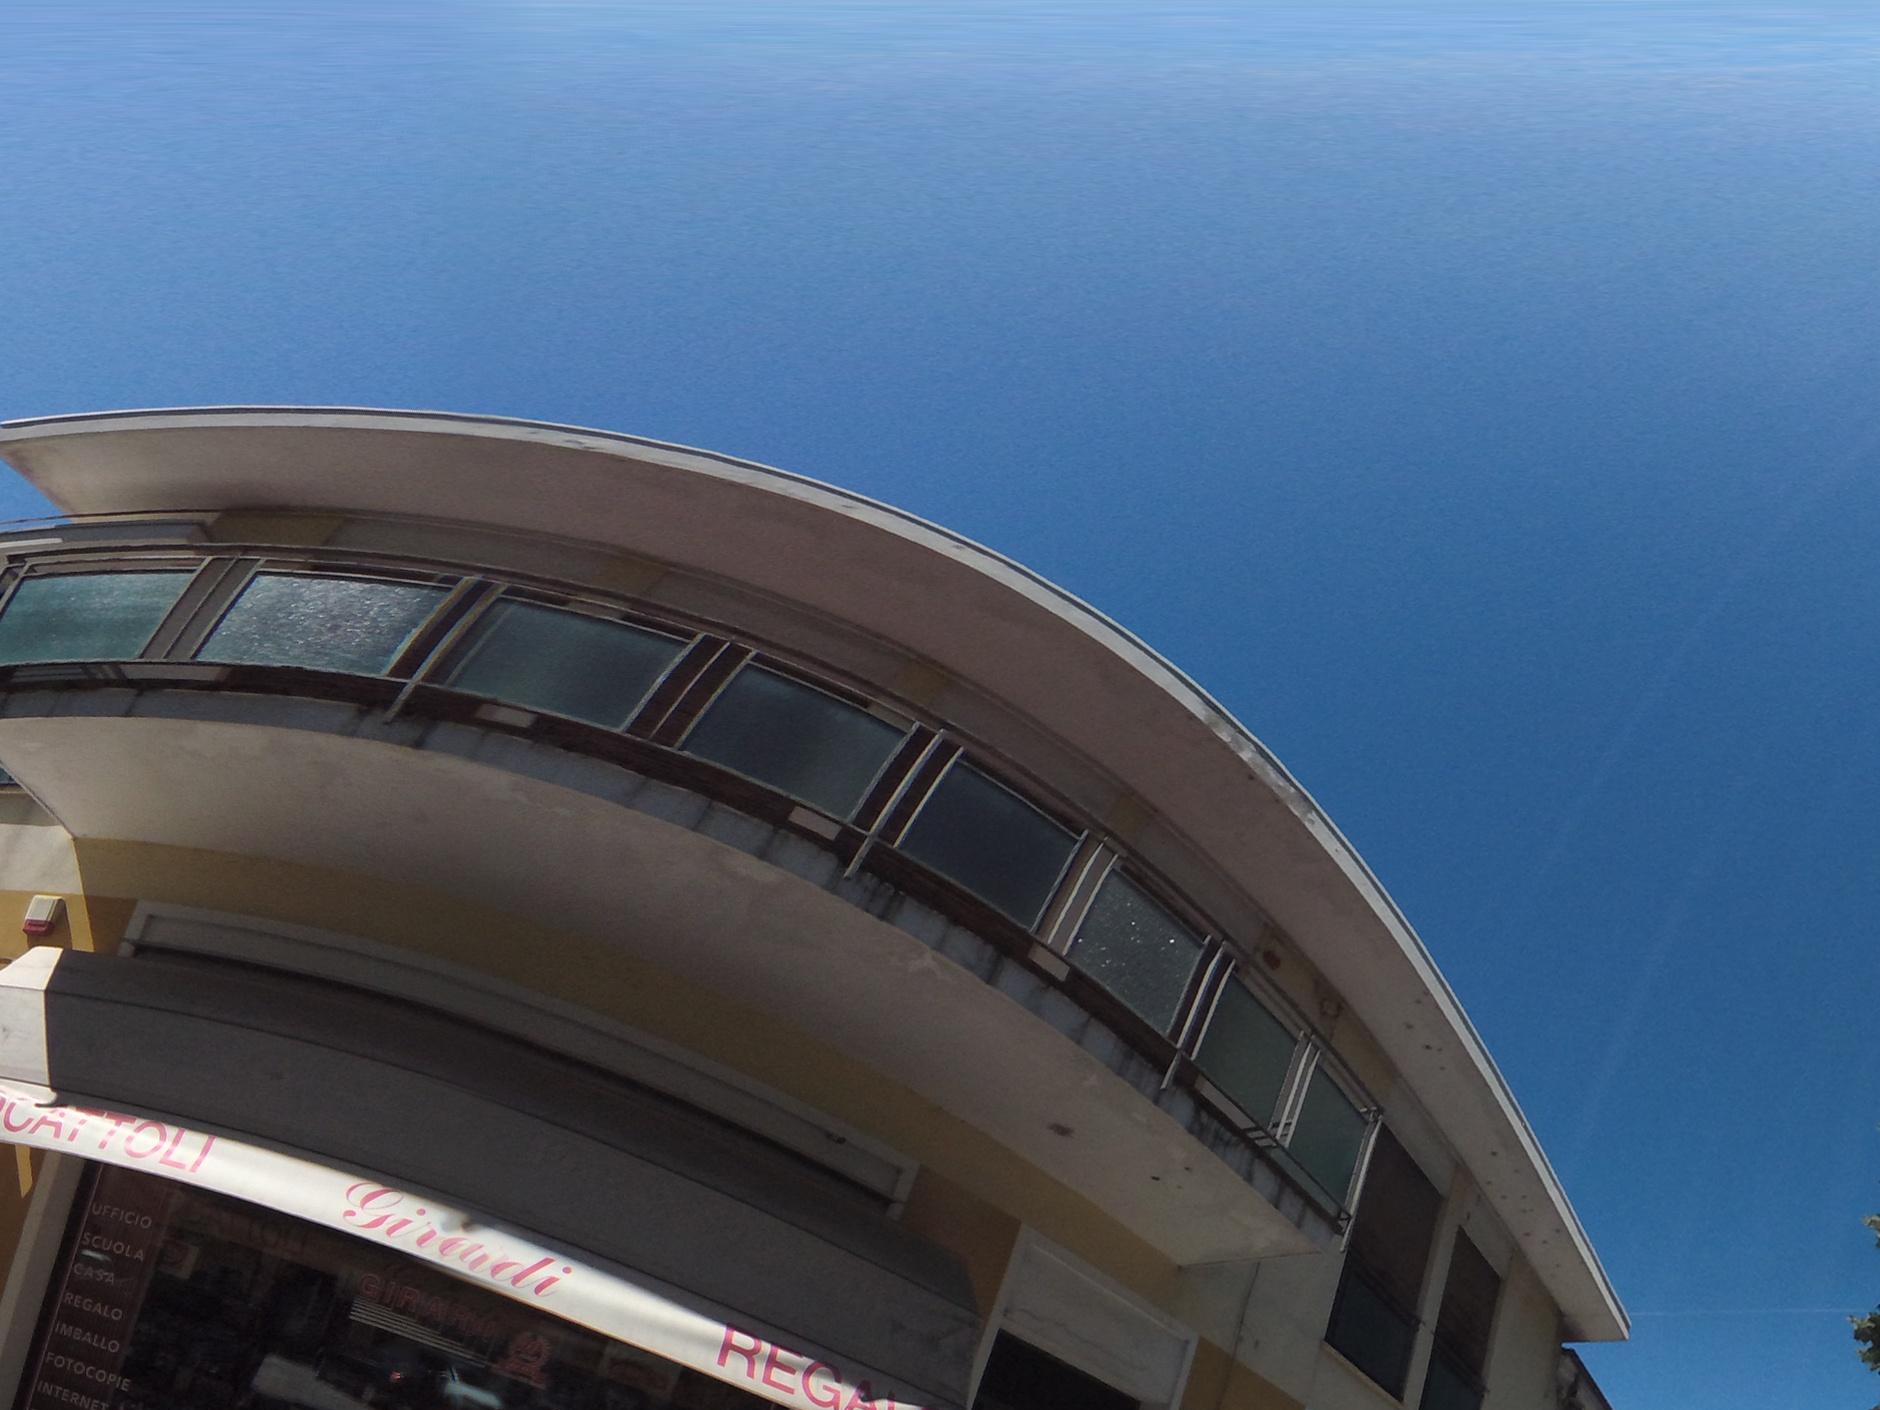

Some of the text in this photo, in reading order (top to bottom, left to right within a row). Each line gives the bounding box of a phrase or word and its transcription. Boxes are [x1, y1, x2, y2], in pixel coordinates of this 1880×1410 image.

[92, 1202, 152, 1229] UFFICIO
[82, 1231, 145, 1262] SCUOLA
[343, 1182, 573, 1297] Girardi
[72, 1262, 116, 1285] CASA
[62, 1291, 124, 1320] REGALO
[54, 1322, 120, 1353] IMBALLO
[44, 1351, 131, 1392] FOTOCOPIE
